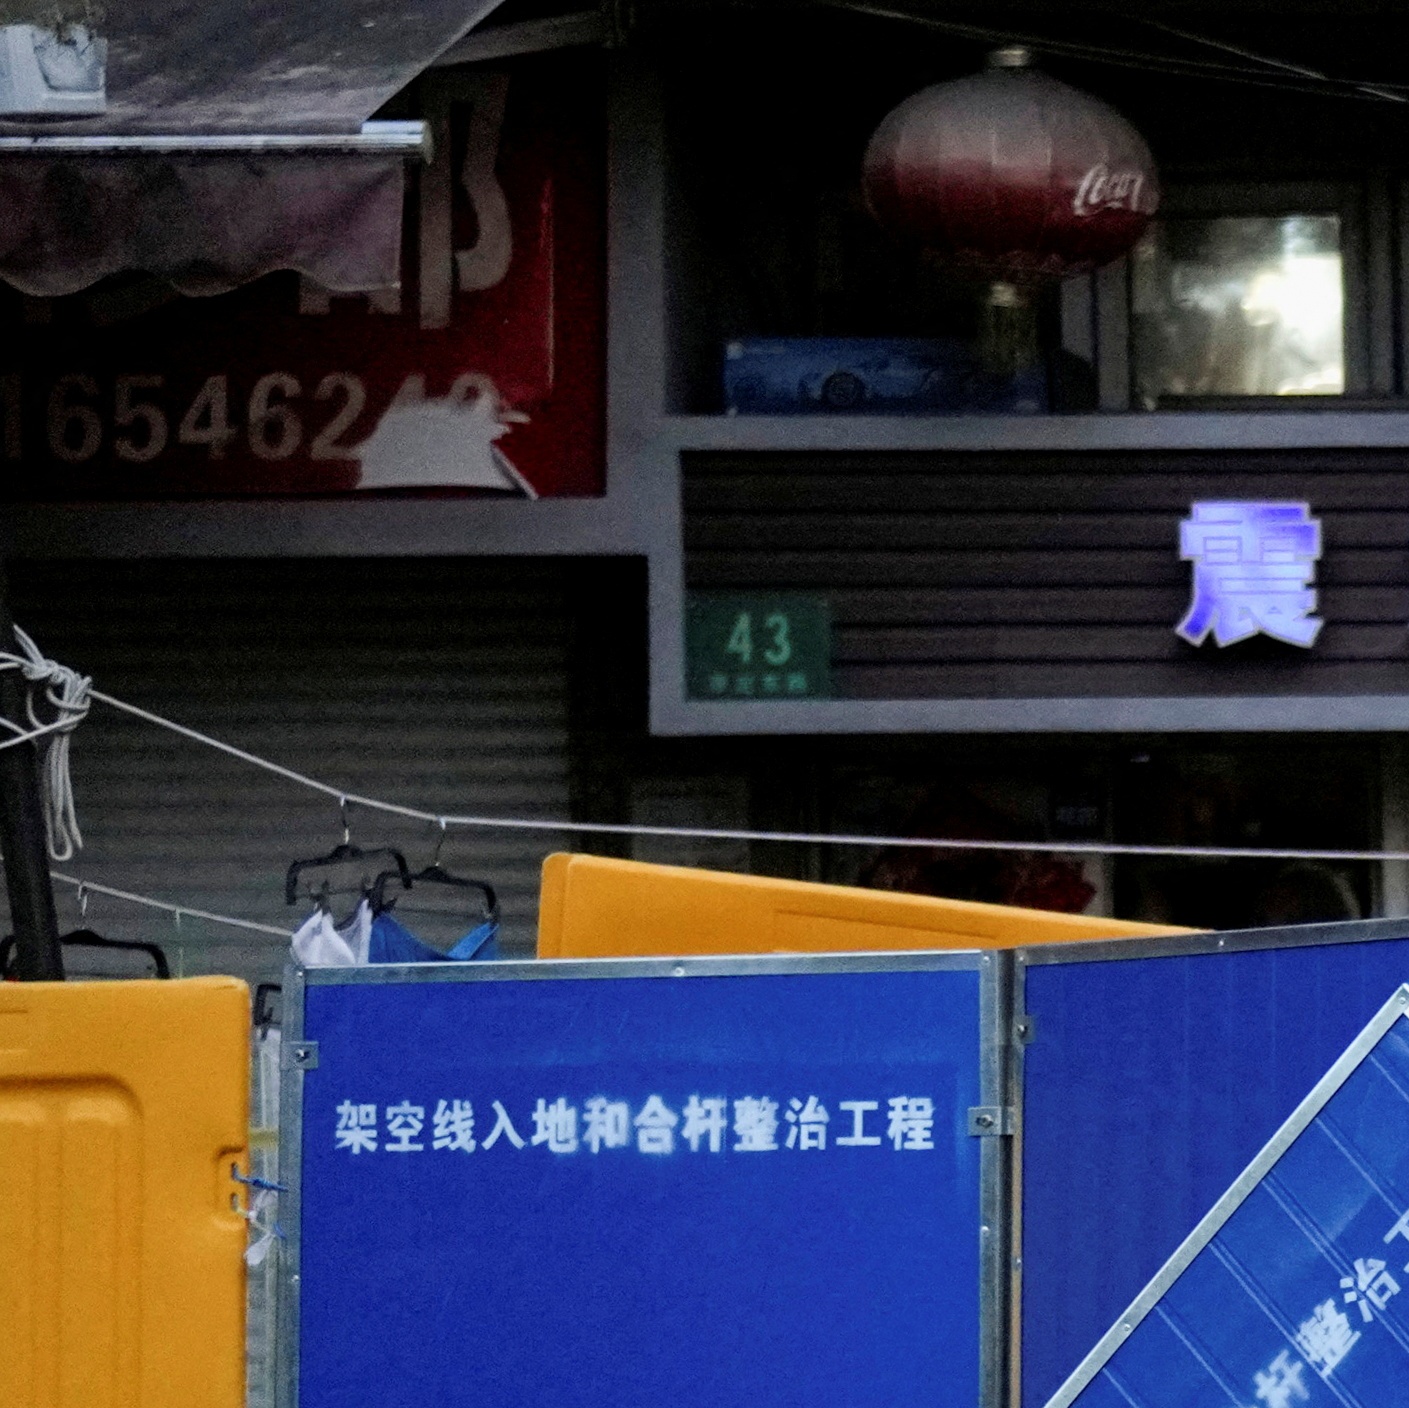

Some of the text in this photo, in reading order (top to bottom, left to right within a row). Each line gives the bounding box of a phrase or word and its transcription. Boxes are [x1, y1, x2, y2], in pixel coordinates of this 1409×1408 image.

[725, 612, 792, 666] 43
[335, 1094, 934, 1154] 架空线入地和合杆整治工程
